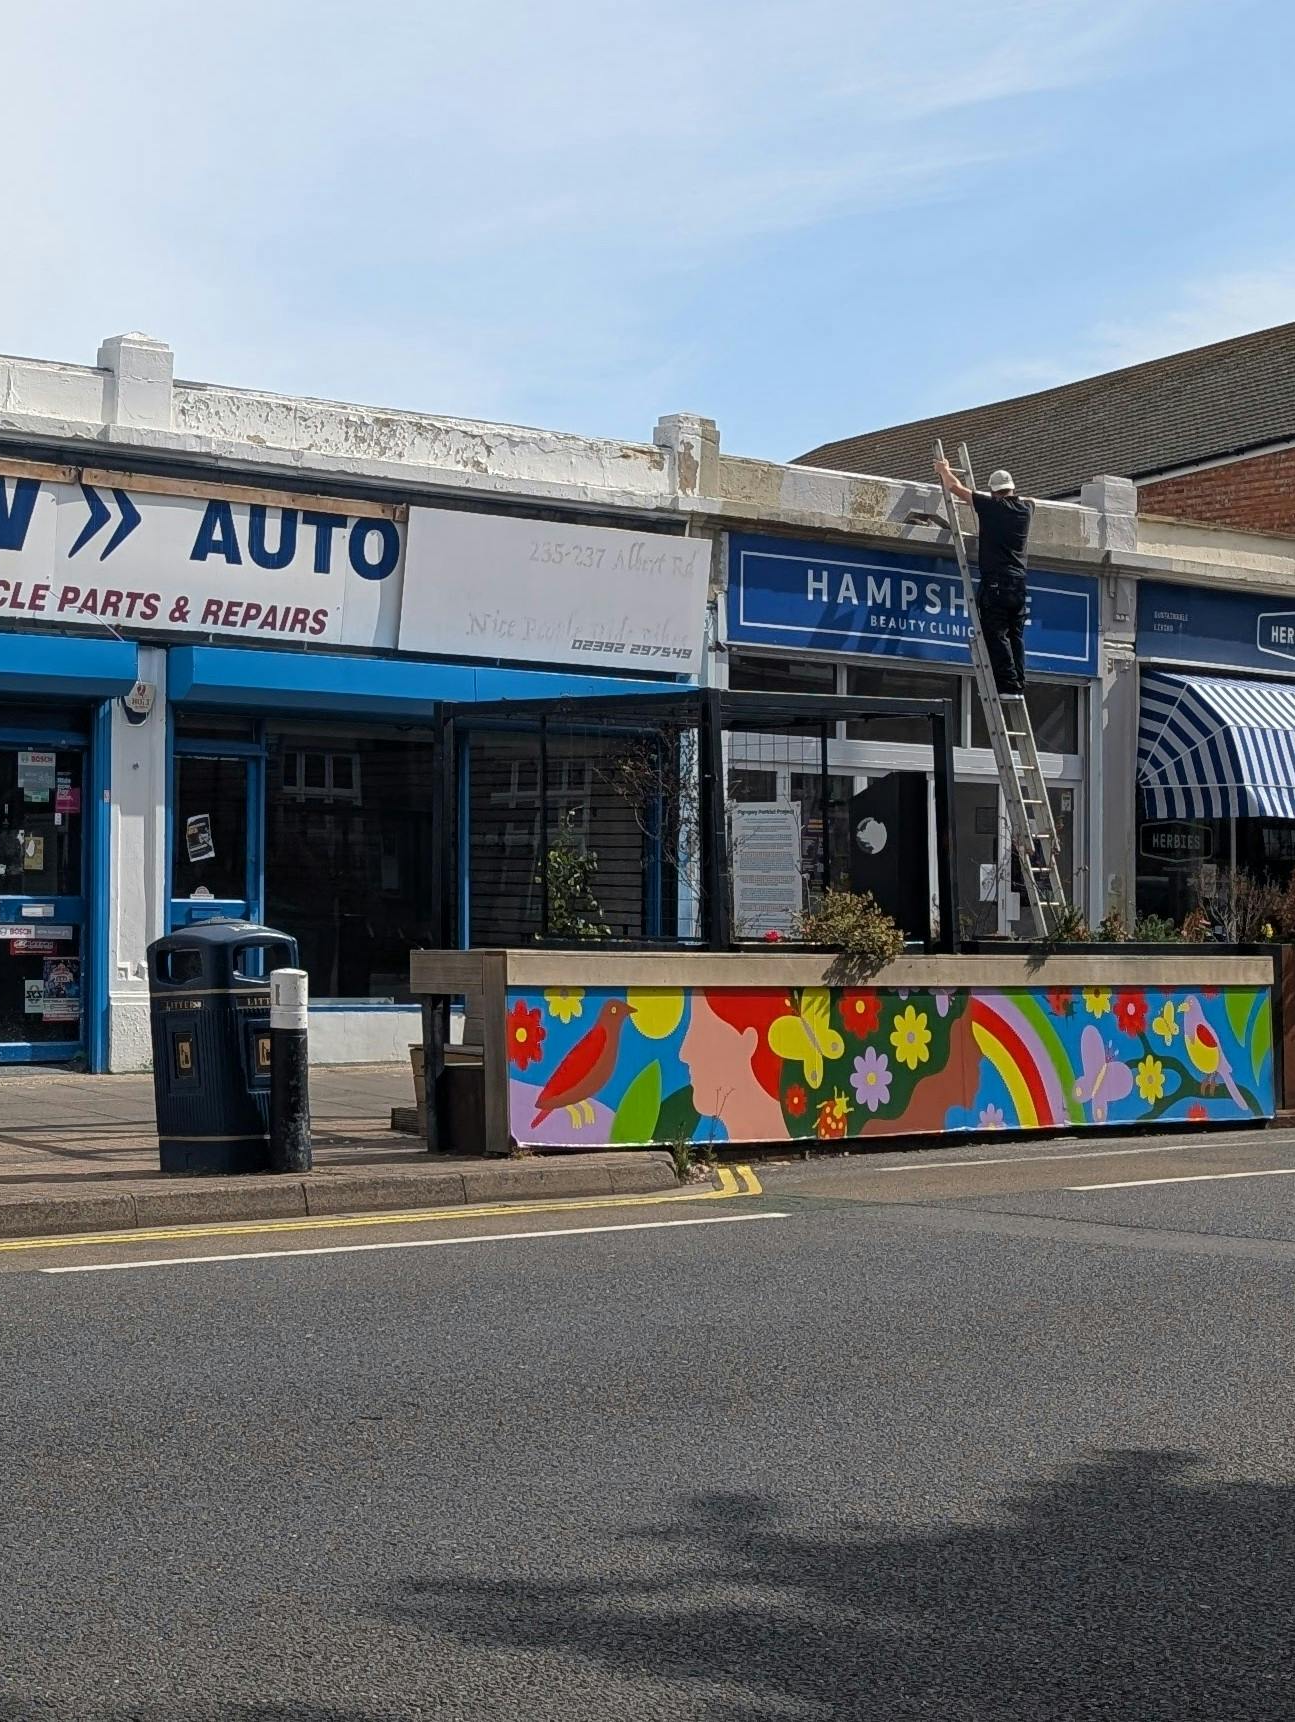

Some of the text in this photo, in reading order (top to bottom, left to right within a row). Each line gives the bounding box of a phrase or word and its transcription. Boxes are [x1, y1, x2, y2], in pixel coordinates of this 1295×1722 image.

[190, 499, 400, 581] AUTO
[806, 568, 1032, 626] HAMPSH
[56, 585, 161, 621] PARTS
[168, 595, 191, 624] &
[200, 598, 329, 636] REPAIRS
[869, 614, 975, 638] BEAUTY CLINIC
[571, 639, 693, 659] 02392 297549
[1152, 832, 1201, 850] HERBIES
[9, 926, 32, 936] BOSCH
